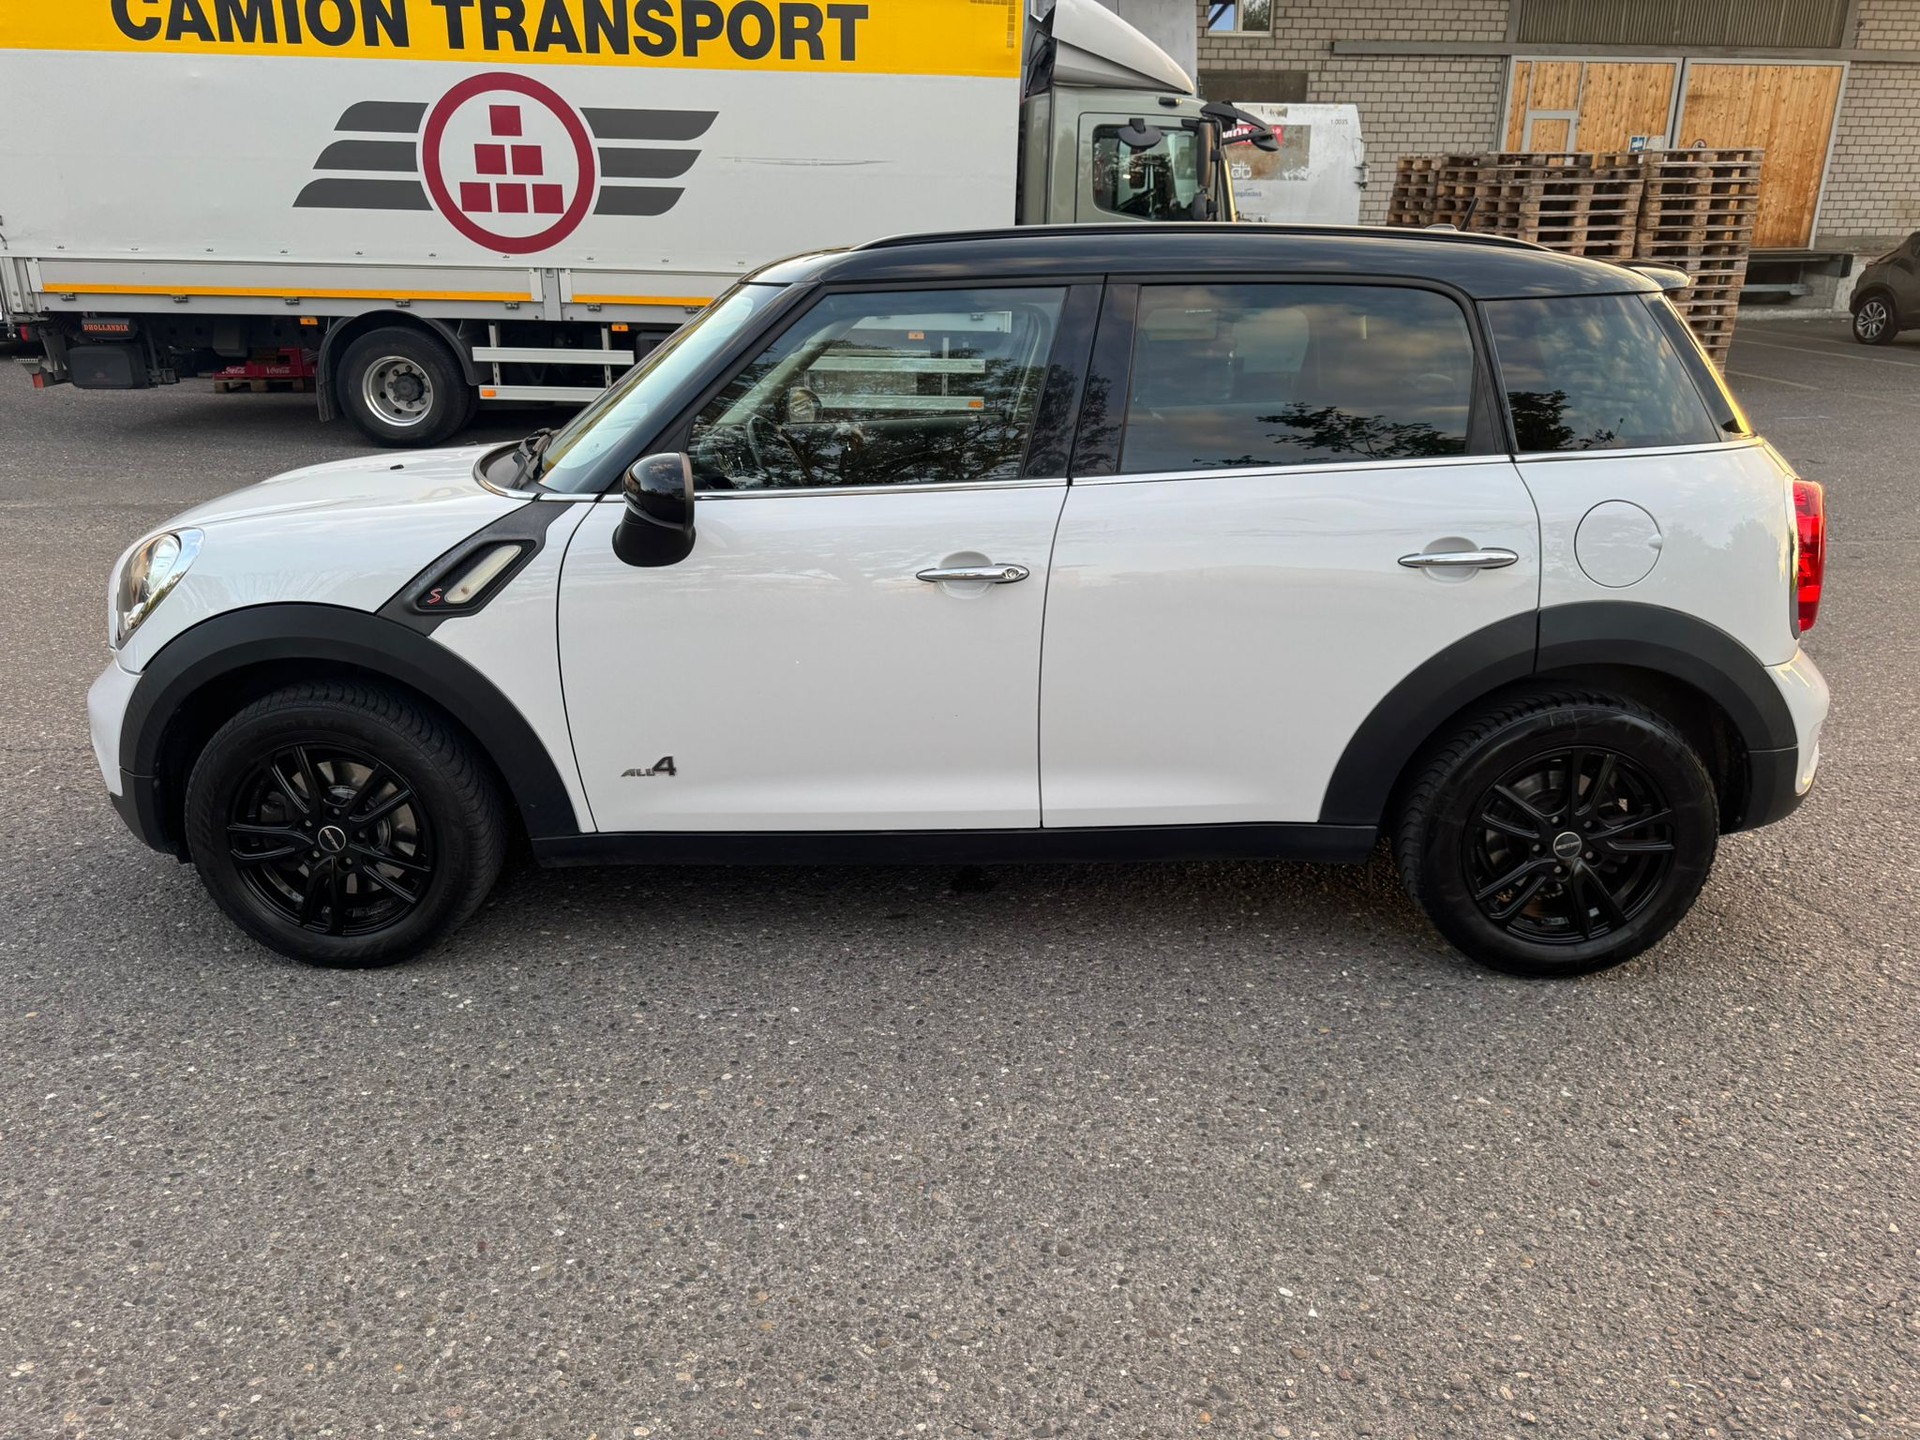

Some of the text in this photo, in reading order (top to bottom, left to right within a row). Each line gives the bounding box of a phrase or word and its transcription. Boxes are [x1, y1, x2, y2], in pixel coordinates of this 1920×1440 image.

[111, 0, 869, 61] CAMION TRANSPORT
[426, 587, 443, 604] S
